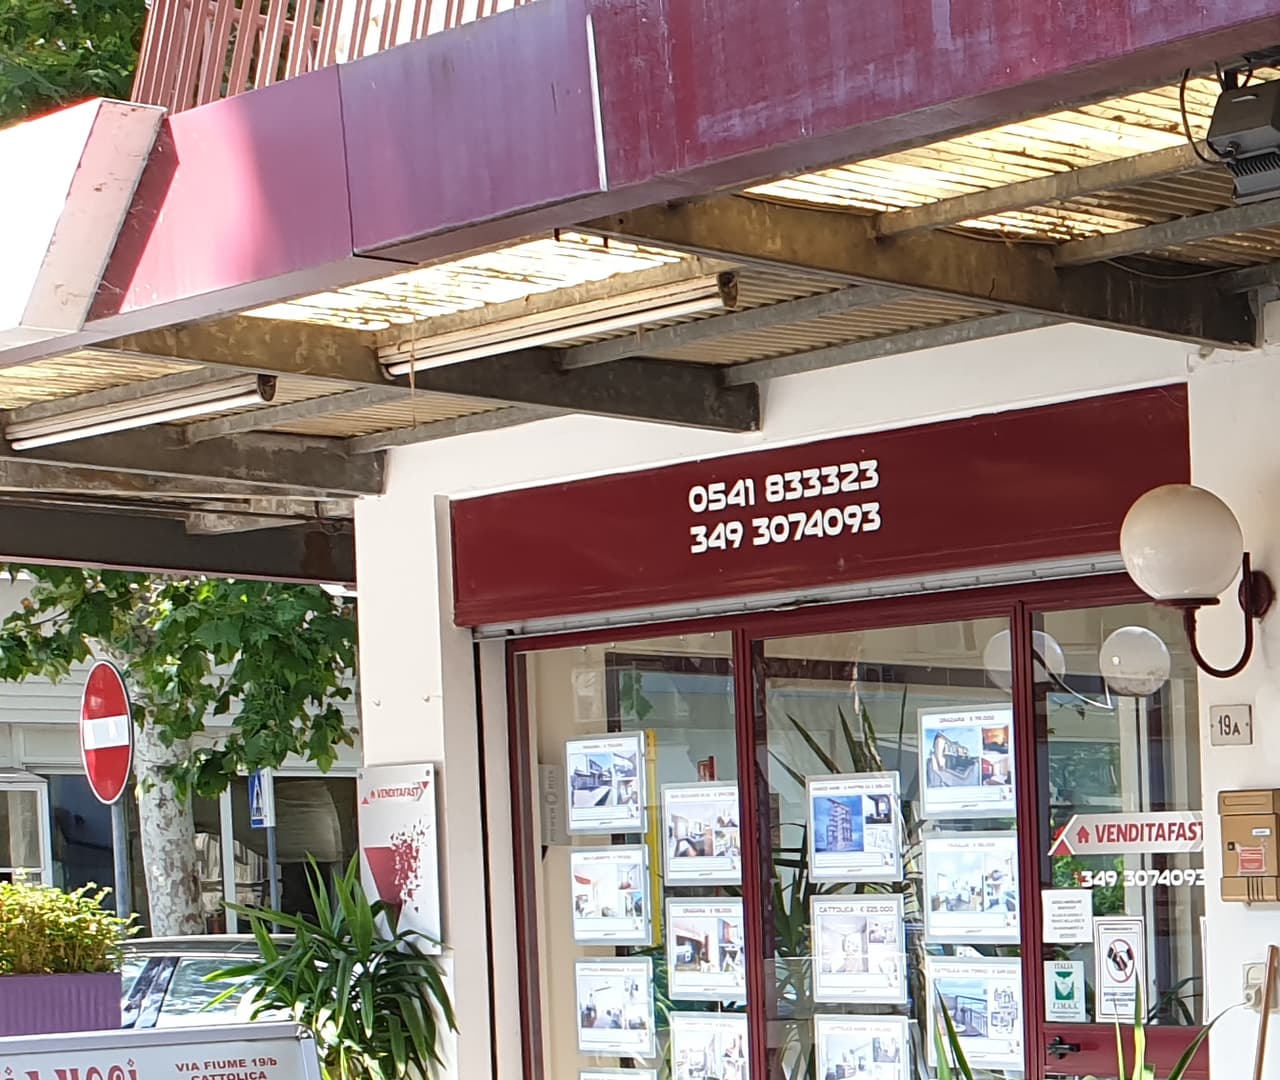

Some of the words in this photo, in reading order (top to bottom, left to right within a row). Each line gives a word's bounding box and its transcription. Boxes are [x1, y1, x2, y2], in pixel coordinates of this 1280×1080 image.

[688, 478, 755, 513] 0541
[765, 459, 880, 502] 833323
[690, 521, 744, 554] 349
[752, 502, 881, 546] 3074093
[1218, 714, 1241, 736] 19A
[377, 786, 420, 800] VENDITAFAST
[1081, 870, 1118, 887] 349
[175, 1061, 201, 1072] VIA
[204, 1059, 247, 1071] FIUME
[251, 1057, 277, 1067] 19/b
